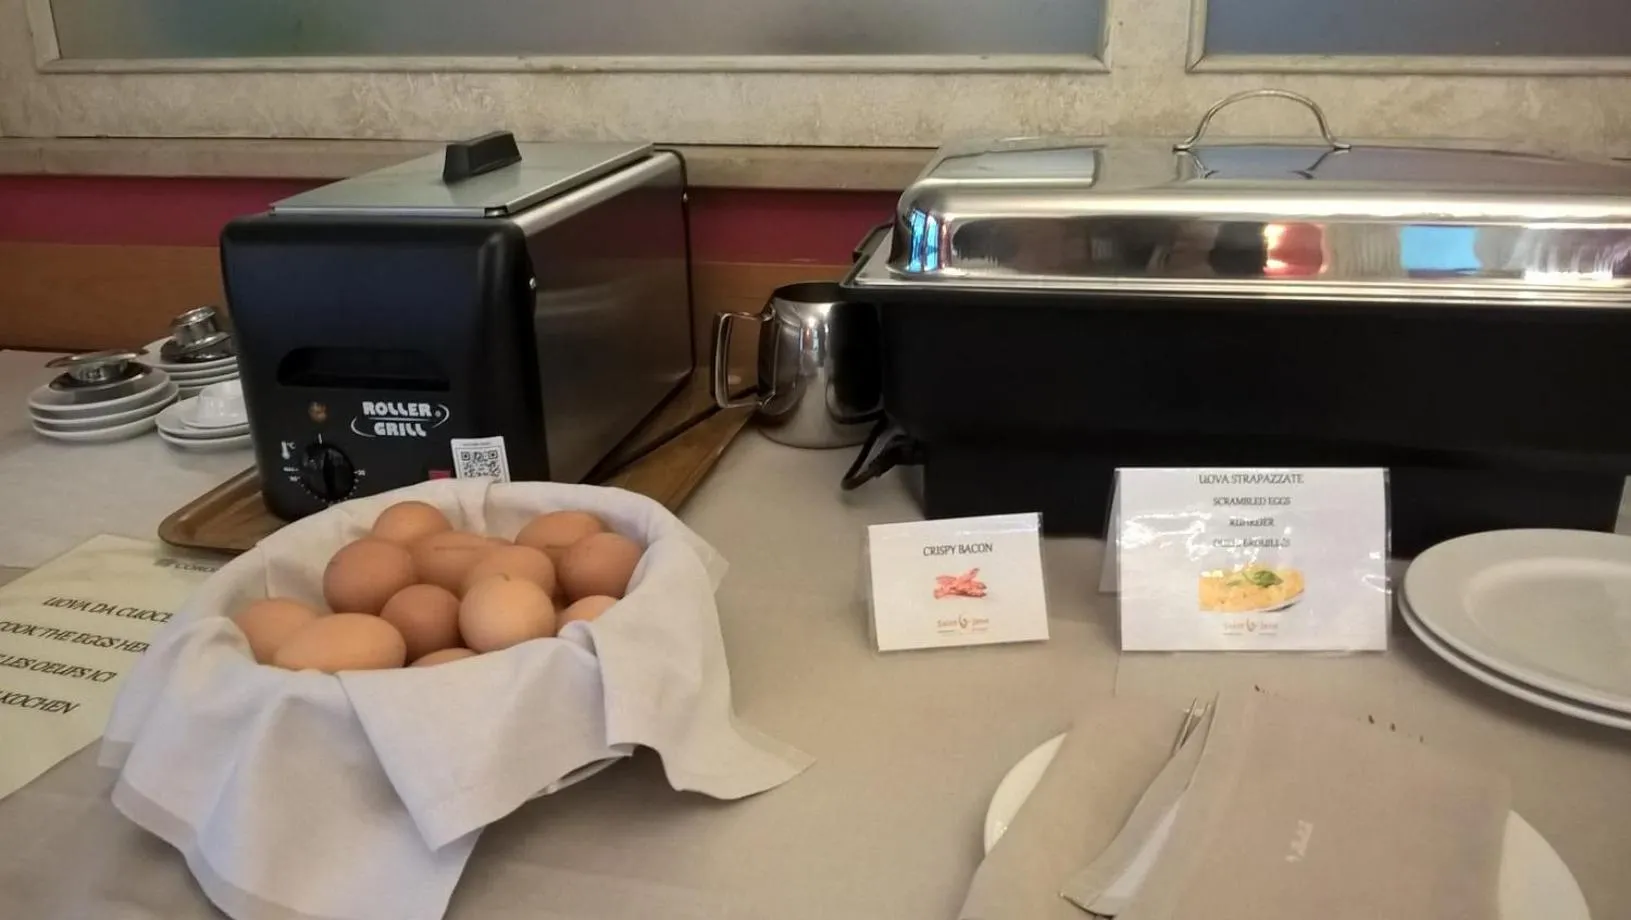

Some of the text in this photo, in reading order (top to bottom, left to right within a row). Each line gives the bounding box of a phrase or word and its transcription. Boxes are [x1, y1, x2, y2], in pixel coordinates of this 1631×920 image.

[362, 401, 432, 417] ROLLER
[373, 422, 427, 437] GRILL
[1199, 474, 1304, 484] UOVA STRAPAZZATE
[1213, 496, 1291, 506] SCRAMBLED EGGS
[922, 542, 993, 556] CRISPY BACON
[42, 597, 89, 612] UOVA
[87, 602, 118, 615] DA
[37, 626, 77, 642] THE
[71, 632, 120, 648] EGGS
[29, 660, 93, 678] OEUFS
[84, 669, 118, 683] ICI
